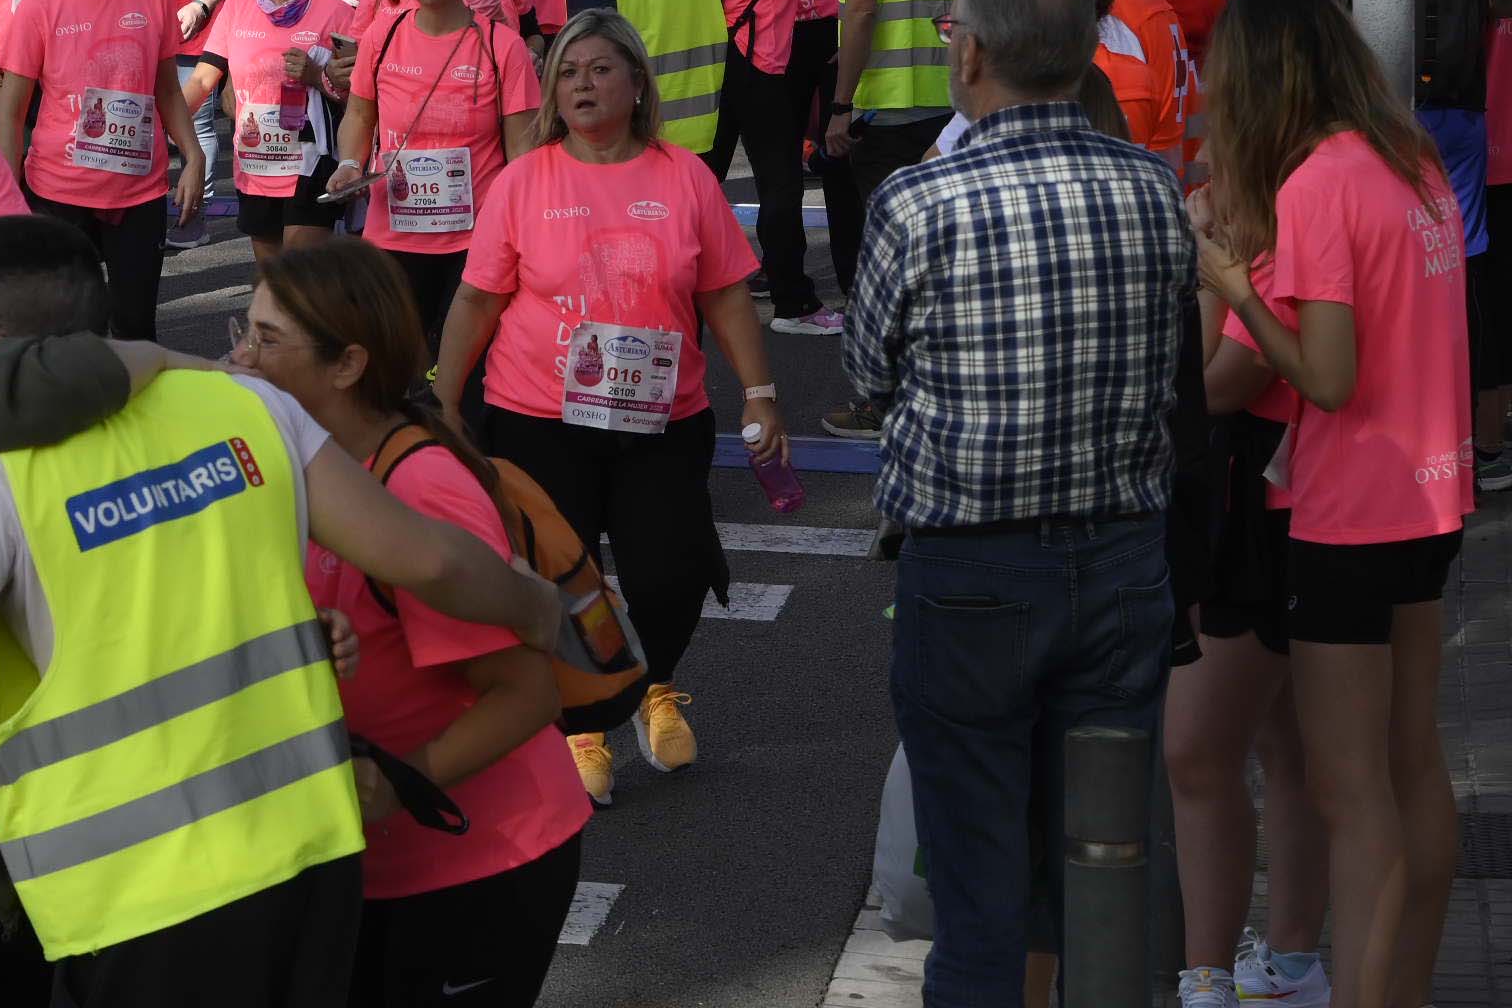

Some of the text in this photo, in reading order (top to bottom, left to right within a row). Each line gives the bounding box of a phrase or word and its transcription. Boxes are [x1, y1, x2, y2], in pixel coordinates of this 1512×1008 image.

[55, 22, 92, 37] OYSHO
[386, 63, 423, 76] OYSHO
[108, 122, 136, 137] 016
[108, 137, 133, 148] 27093
[263, 132, 291, 143] 016
[411, 182, 440, 196] 016
[414, 197, 437, 206] 27094
[543, 206, 590, 220] OYSHO
[608, 343, 648, 357] ASTURIANA
[607, 367, 642, 384] 016
[607, 386, 636, 398] 26109
[577, 394, 608, 406] CARRERA
[608, 399, 619, 407] DE
[619, 400, 628, 408] LA
[628, 401, 648, 410] MUJER
[572, 408, 607, 421] OYSHO
